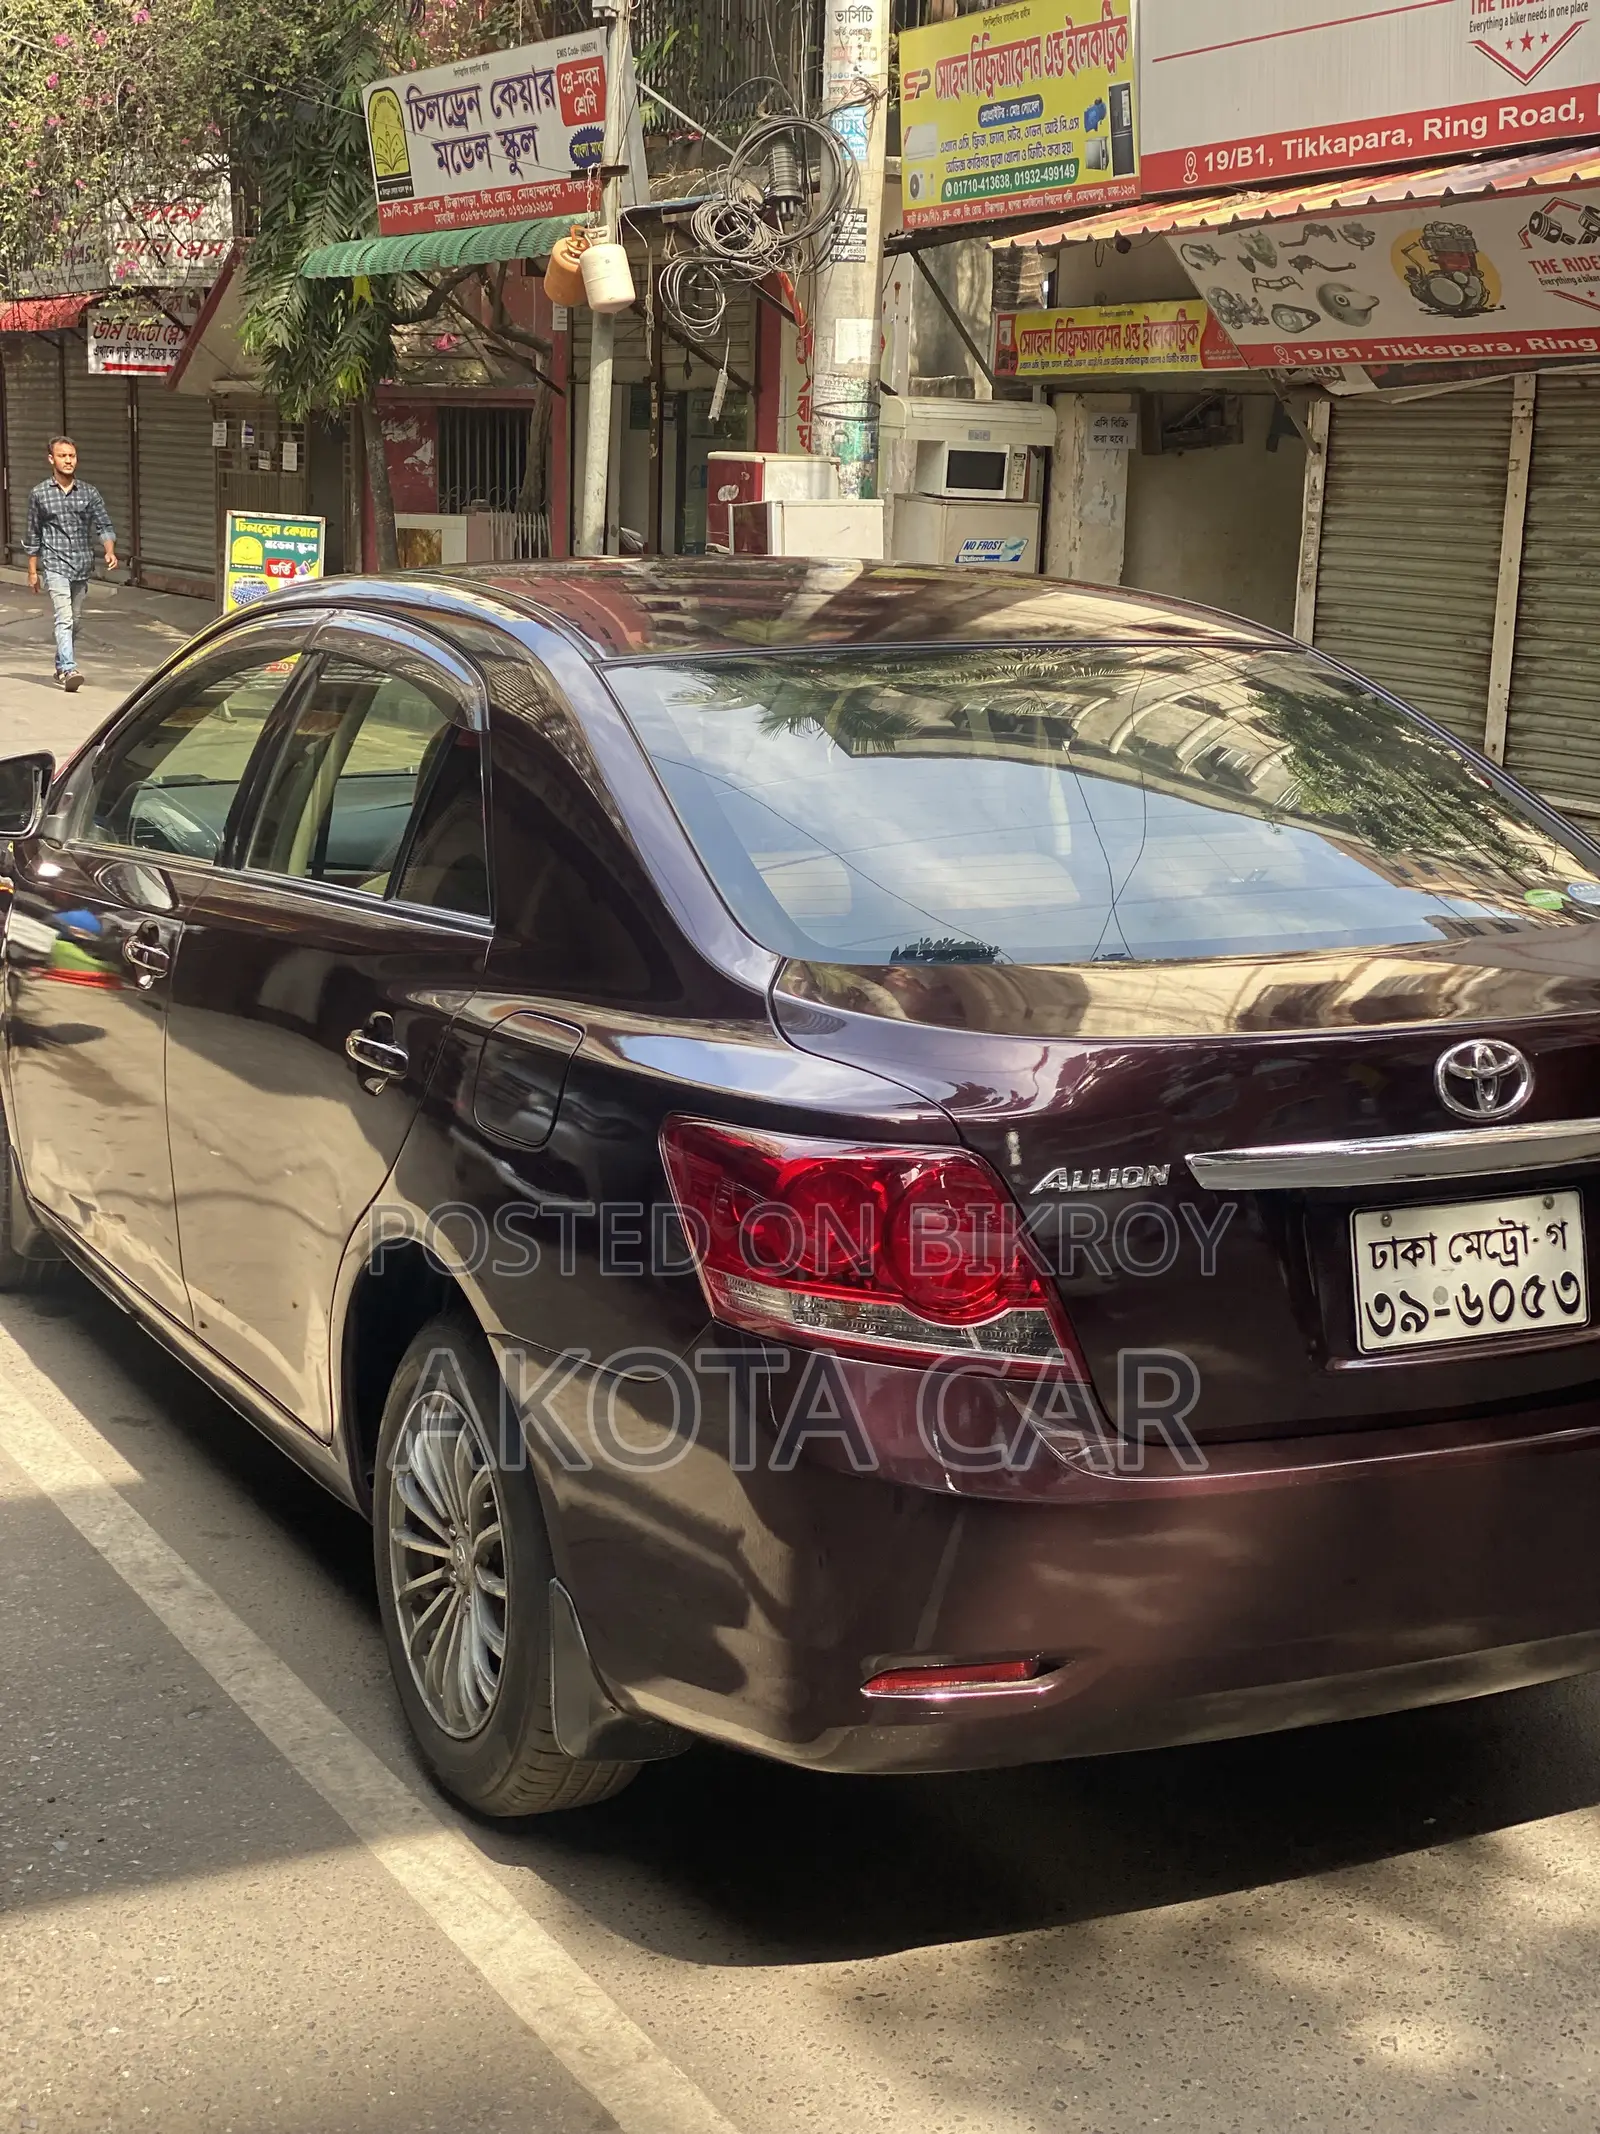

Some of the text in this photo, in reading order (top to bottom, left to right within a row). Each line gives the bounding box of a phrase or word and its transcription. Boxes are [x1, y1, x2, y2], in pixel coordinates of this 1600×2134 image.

[834, 5, 874, 23] ভার্সিটি
[1469, 1, 1588, 34] Everything a biker needs in one place
[560, 65, 601, 95] প্লে-নবম
[935, 53, 969, 99] সোহেল
[970, 33, 1042, 99] রিফ্রিজারেশন
[1044, 31, 1064, 77] এন্ড
[405, 84, 483, 136] চিলড্রেন
[490, 65, 558, 120] কেয়ার
[573, 88, 598, 117] শ্রেণি
[1204, 144, 1274, 172] 19/B1,
[1281, 128, 1413, 160] Tikkapara,
[1423, 116, 1488, 142] Ring
[1498, 97, 1585, 131] Road,
[431, 123, 541, 181] মডেল স্কুল
[481, 191, 494, 204] রিং
[495, 189, 515, 204] রোড,
[517, 183, 564, 200] মোহাম্মদপুর,
[953, 163, 1076, 196] 01710-413638, 01932-499149
[1528, 255, 1600, 275] THE RIDE
[1538, 275, 1577, 287] Everything
[1019, 329, 1053, 357] সোহেল
[1053, 317, 1122, 358] রিফ্রিজারেশন
[1124, 323, 1141, 352] এন্ড
[1296, 336, 1599, 362] 19/B1, Tikkapara, Ring
[1094, 416, 1129, 428] এসি বিক্রি
[1093, 434, 1108, 444] করা
[964, 540, 1004, 550] NO FROST
[269, 561, 293, 576] ভর্তি
[1029, 1164, 1171, 1195] ALLION
[1368, 1232, 1438, 1270] ঢাকা
[1364, 1270, 1581, 1338] ৩৯-৬০৫৩
